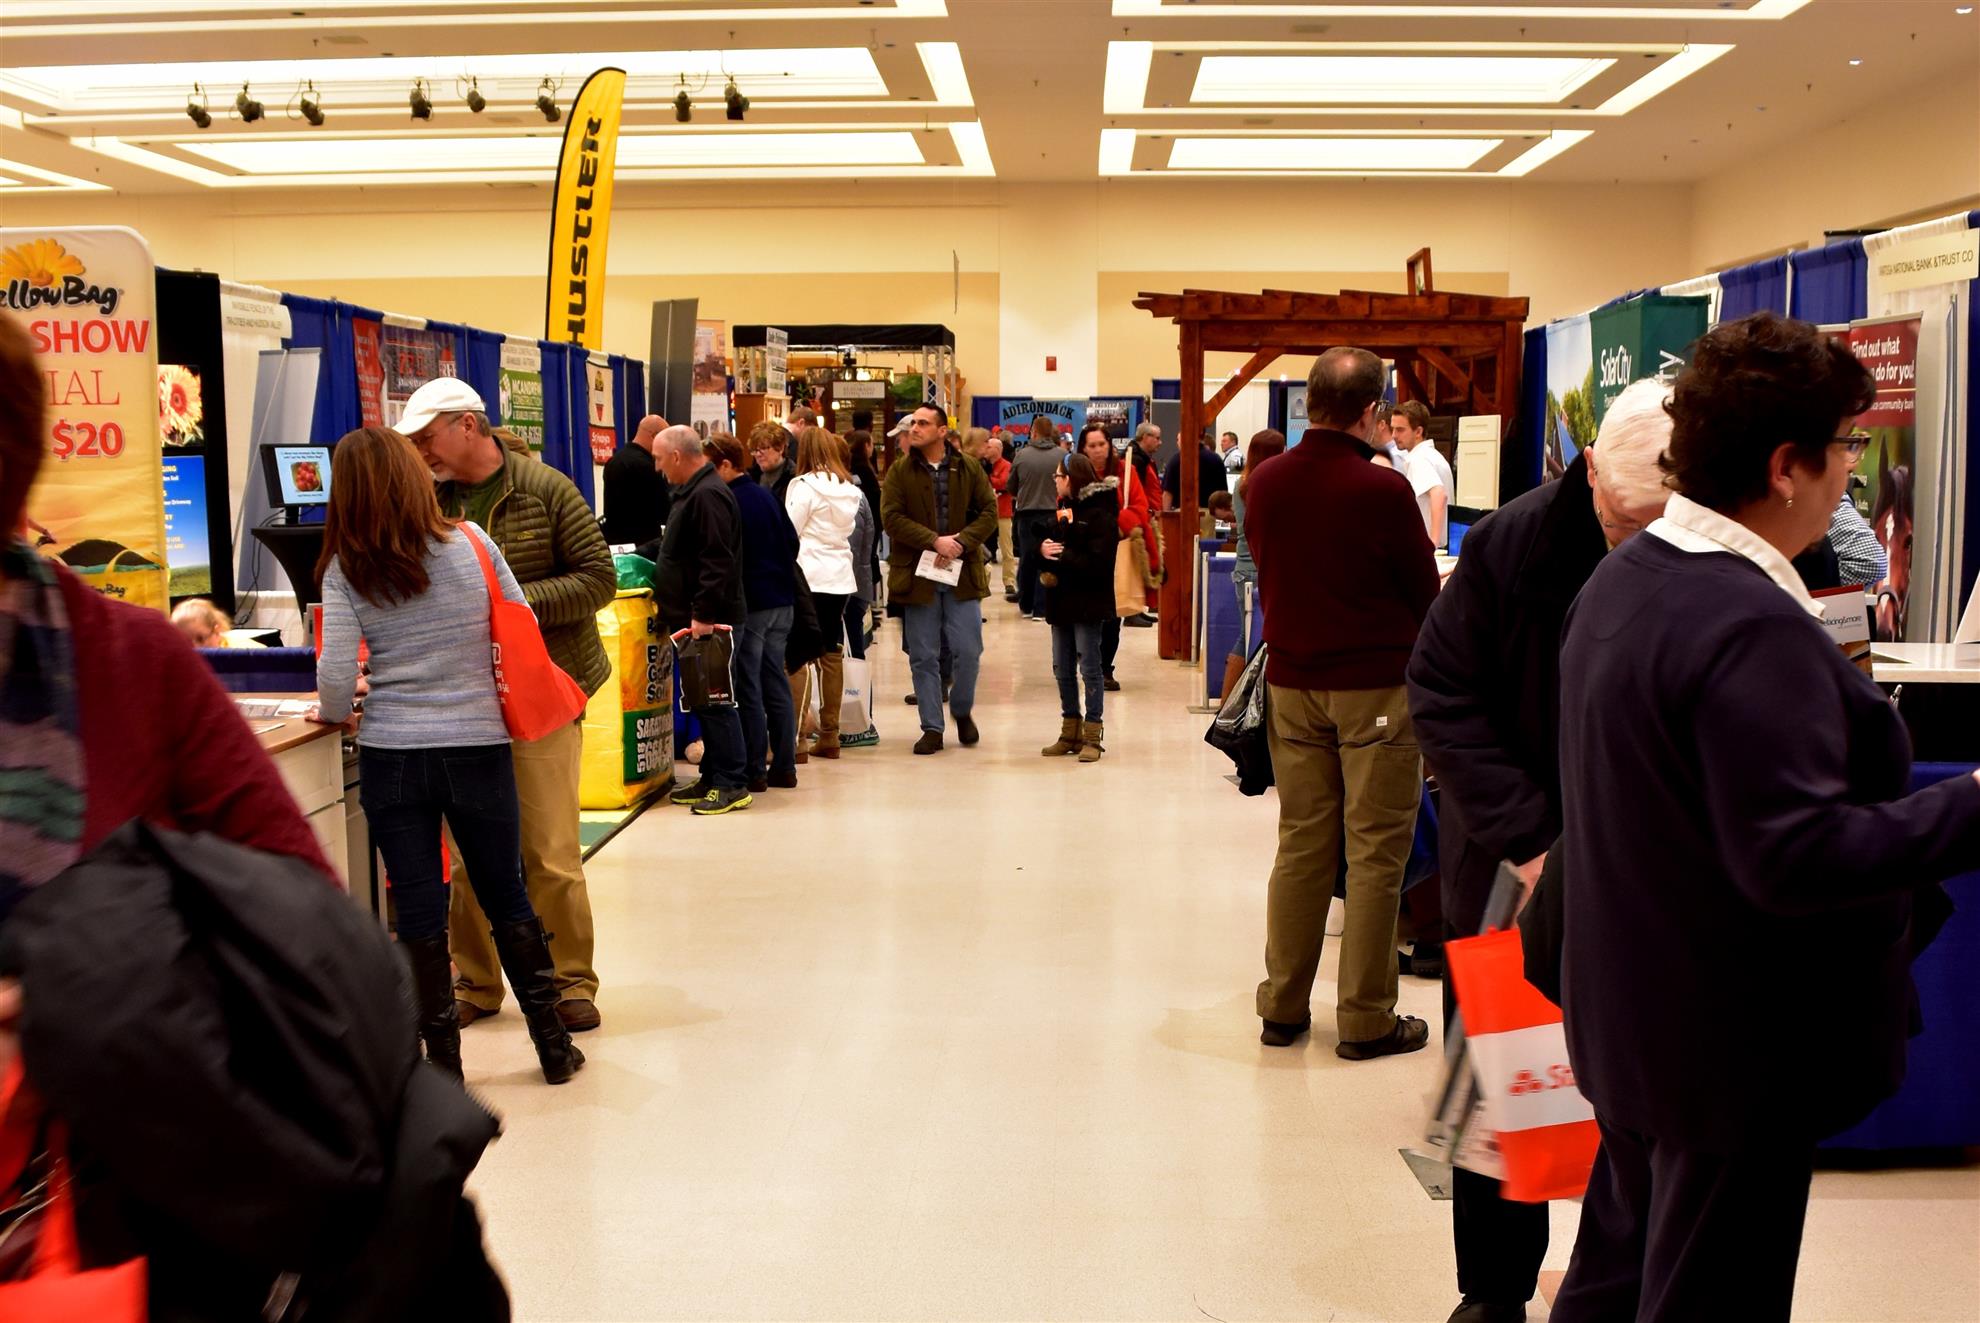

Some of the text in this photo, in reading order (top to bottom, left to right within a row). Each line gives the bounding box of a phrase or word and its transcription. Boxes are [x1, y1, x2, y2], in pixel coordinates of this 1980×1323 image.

[567, 115, 602, 348] HUSTLER
[1916, 257, 1933, 272] BANK
[1961, 250, 1974, 263] CO
[30, 320, 149, 354] SHOW
[1868, 338, 1880, 356] out
[1881, 336, 1900, 356] what
[1600, 345, 1632, 388] SolarCity
[1875, 362, 1886, 381] do
[1885, 361, 1898, 380] for
[1002, 401, 1075, 420] ADIRONDACK
[52, 420, 123, 459] $20
